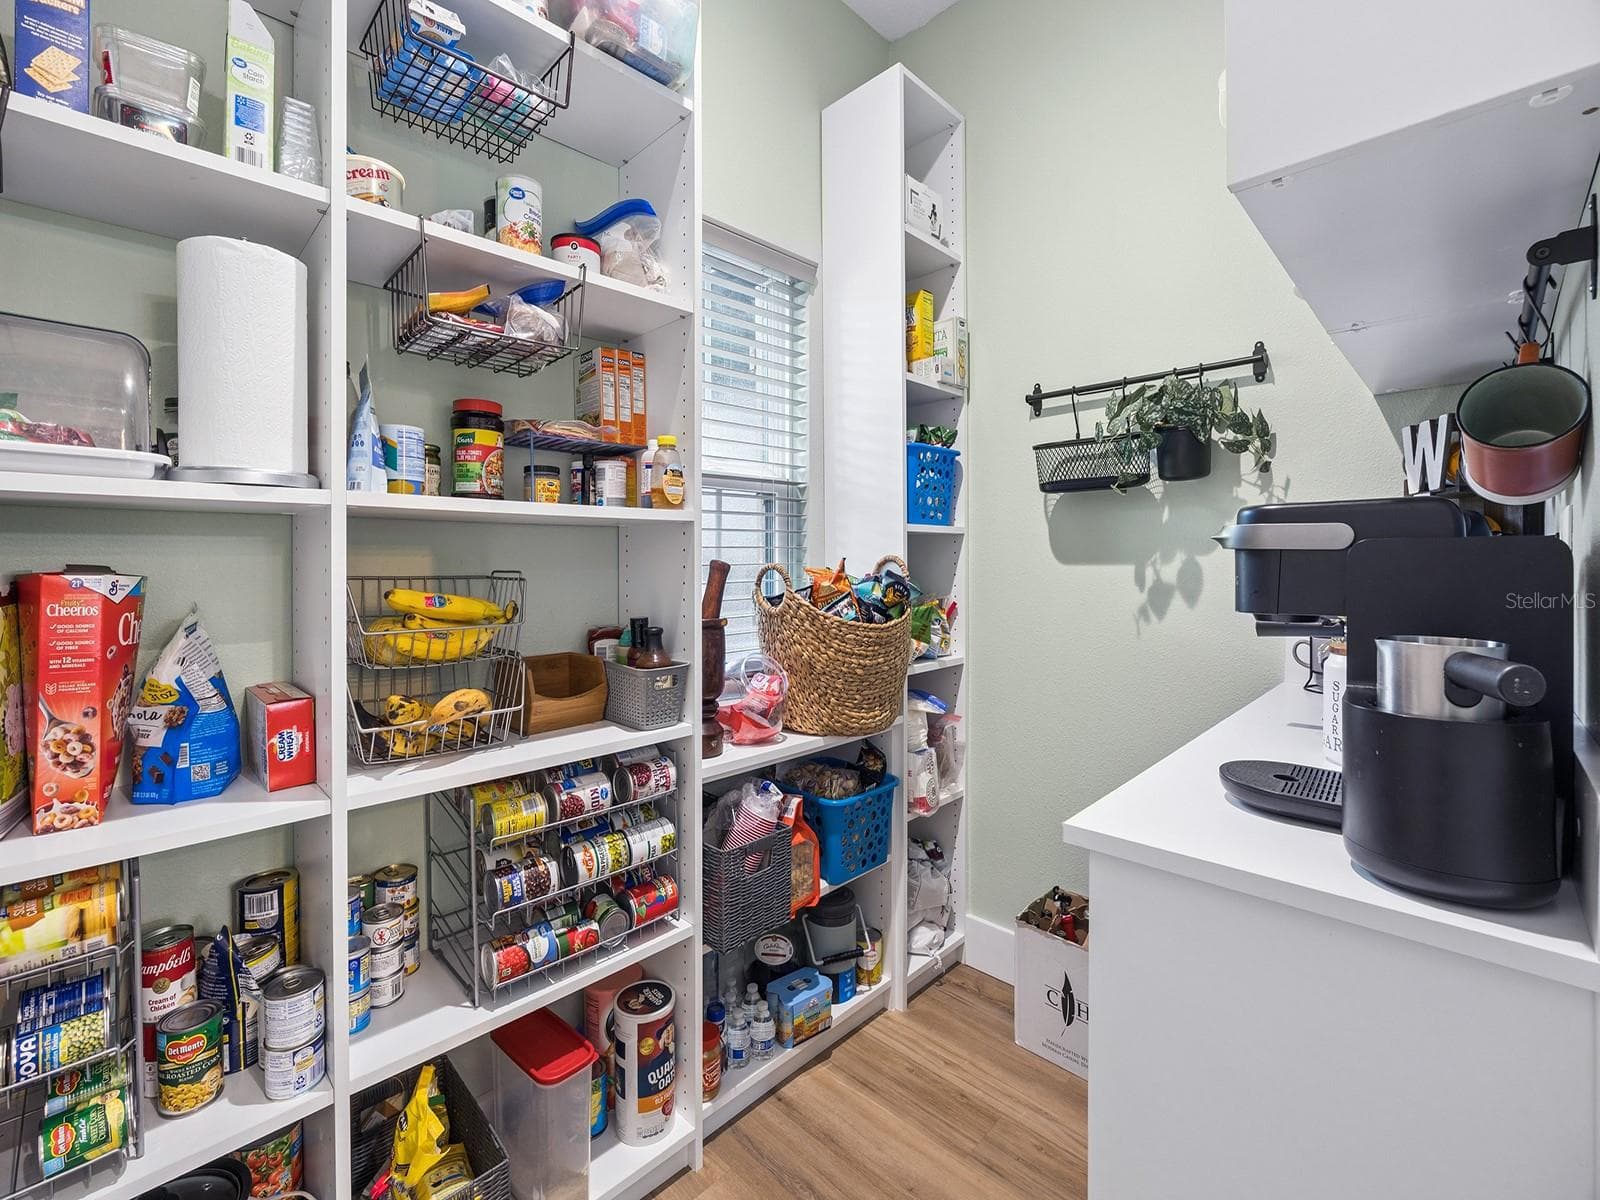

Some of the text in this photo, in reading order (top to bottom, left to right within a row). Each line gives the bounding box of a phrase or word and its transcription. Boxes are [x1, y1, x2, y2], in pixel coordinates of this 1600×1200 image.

[346, 167, 390, 181] cream
[1401, 412, 1448, 496] W
[46, 603, 100, 618] Cheerios
[62, 656, 72, 664] 12
[160, 690, 177, 700] OZ
[278, 731, 286, 761] CREAM
[285, 730, 295, 760] WHEAT
[148, 992, 177, 1006] Cream of
[150, 1001, 176, 1012] Chicken
[167, 1039, 204, 1056] Del Monte
[202, 1054, 220, 1069] CORN
